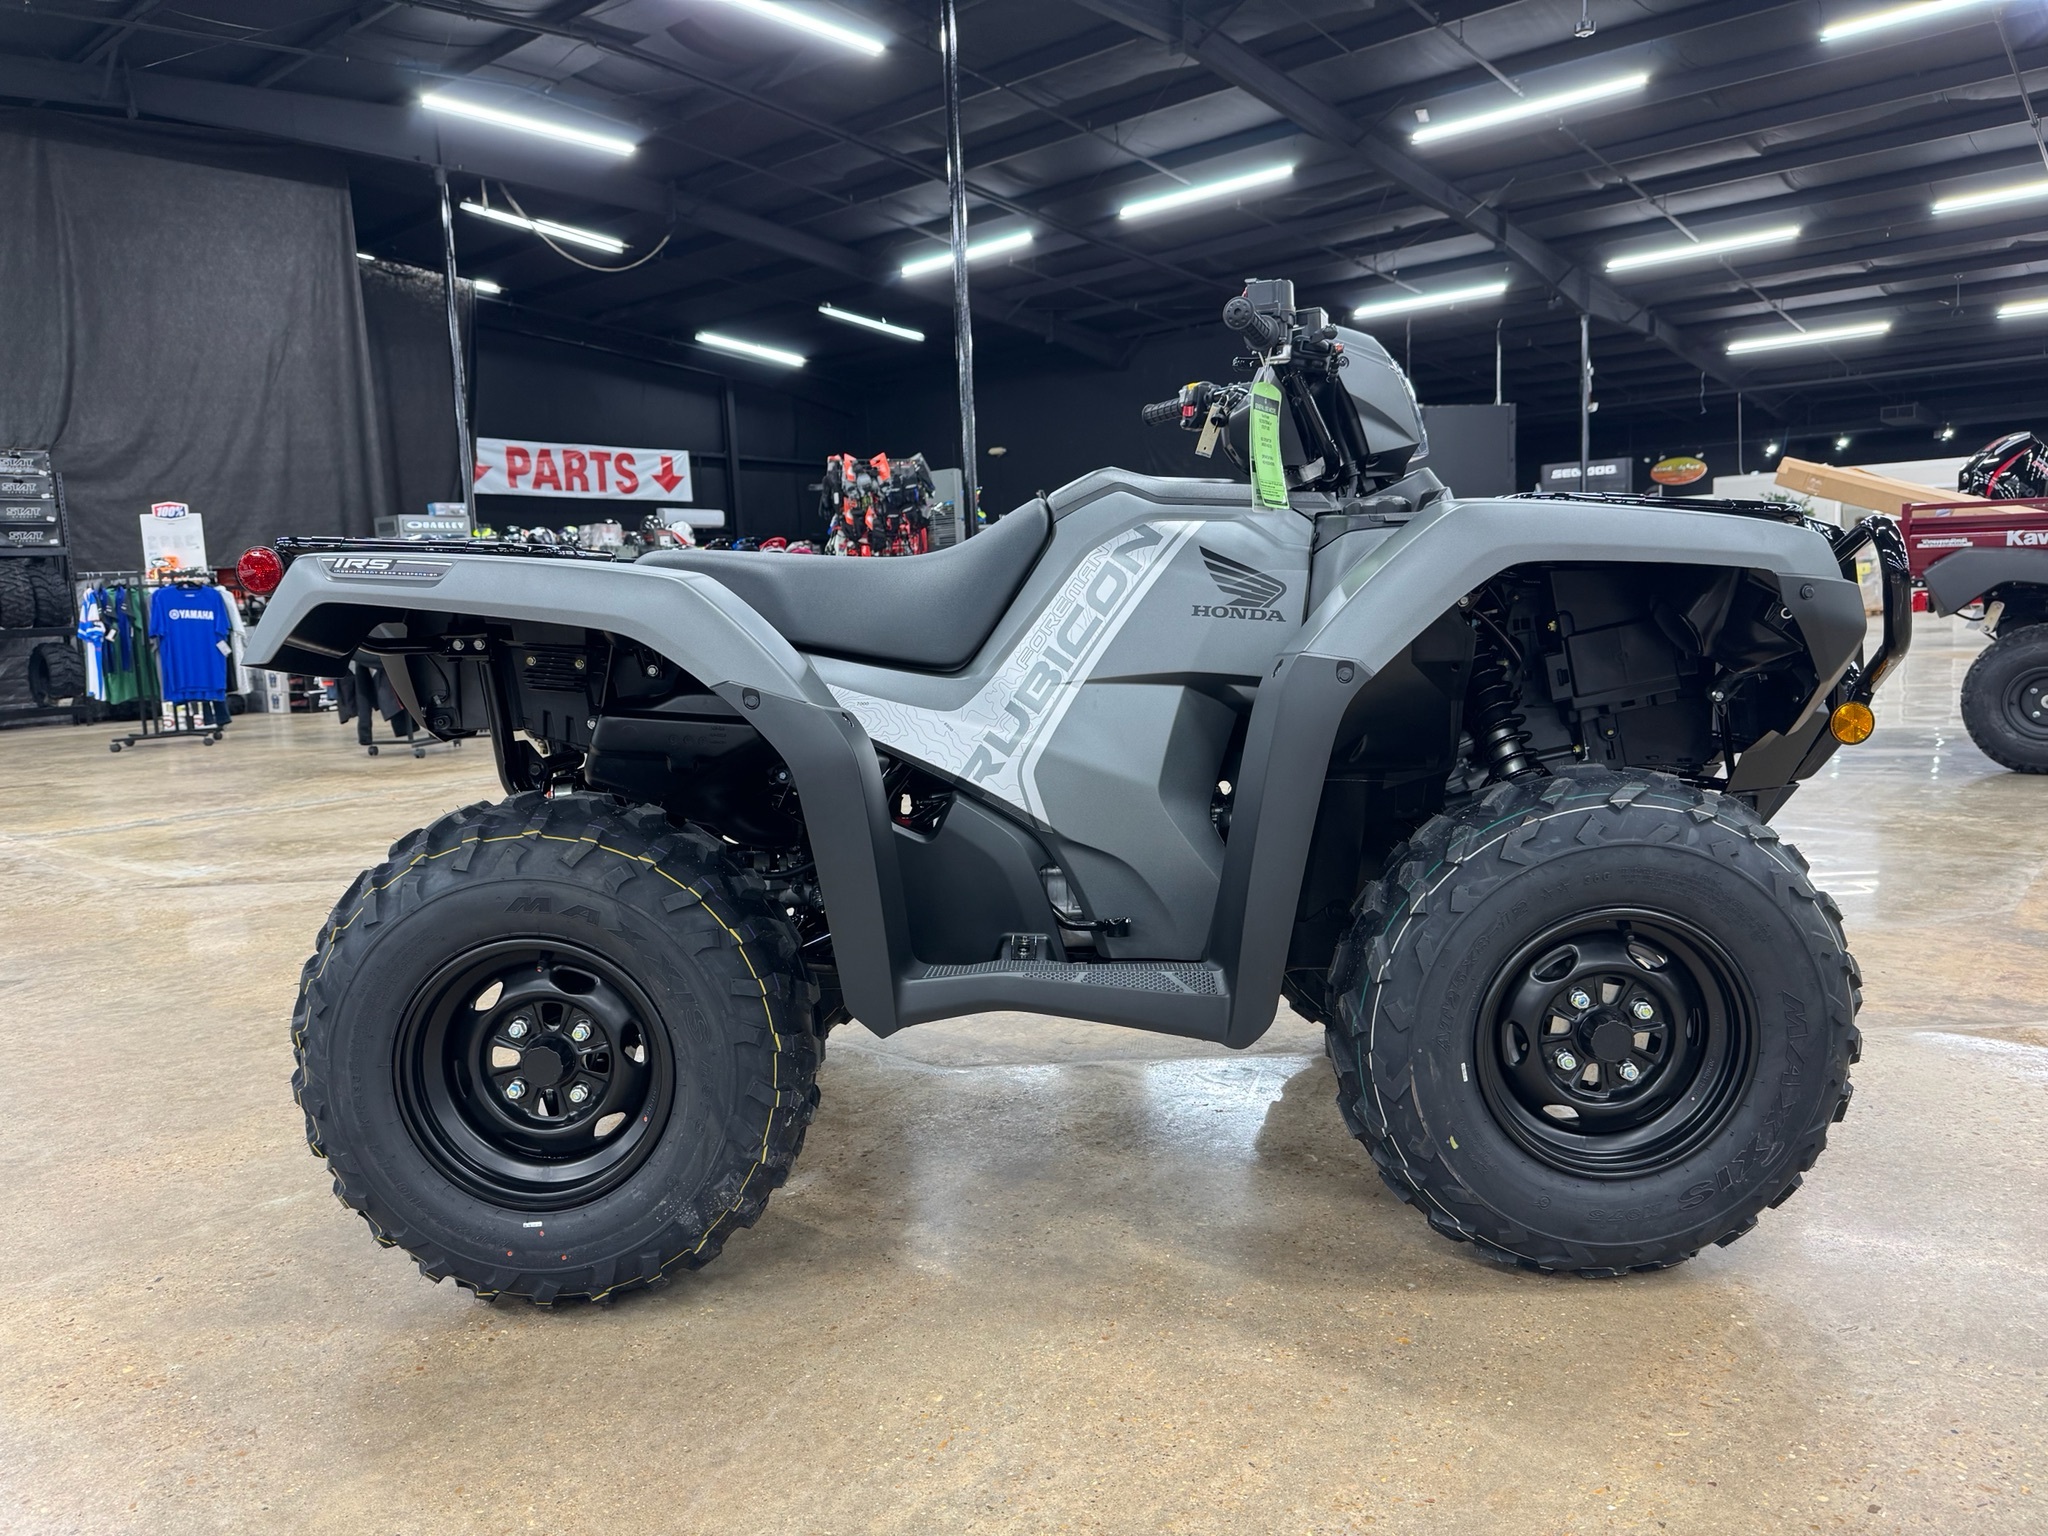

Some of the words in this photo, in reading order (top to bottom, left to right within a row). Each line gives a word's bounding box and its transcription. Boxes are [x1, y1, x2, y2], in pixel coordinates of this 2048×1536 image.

[506, 446, 639, 494] PARTS
[156, 506, 184, 517] 100%
[423, 521, 464, 529] OAKLEY
[334, 559, 393, 570] IRS
[179, 609, 214, 620] YAMAHA
[1016, 545, 1110, 669] FOREMAN
[1191, 605, 1286, 622] HONDA
[959, 523, 1163, 784] RUBICON
[1679, 990, 1808, 1210] MAXXIS
